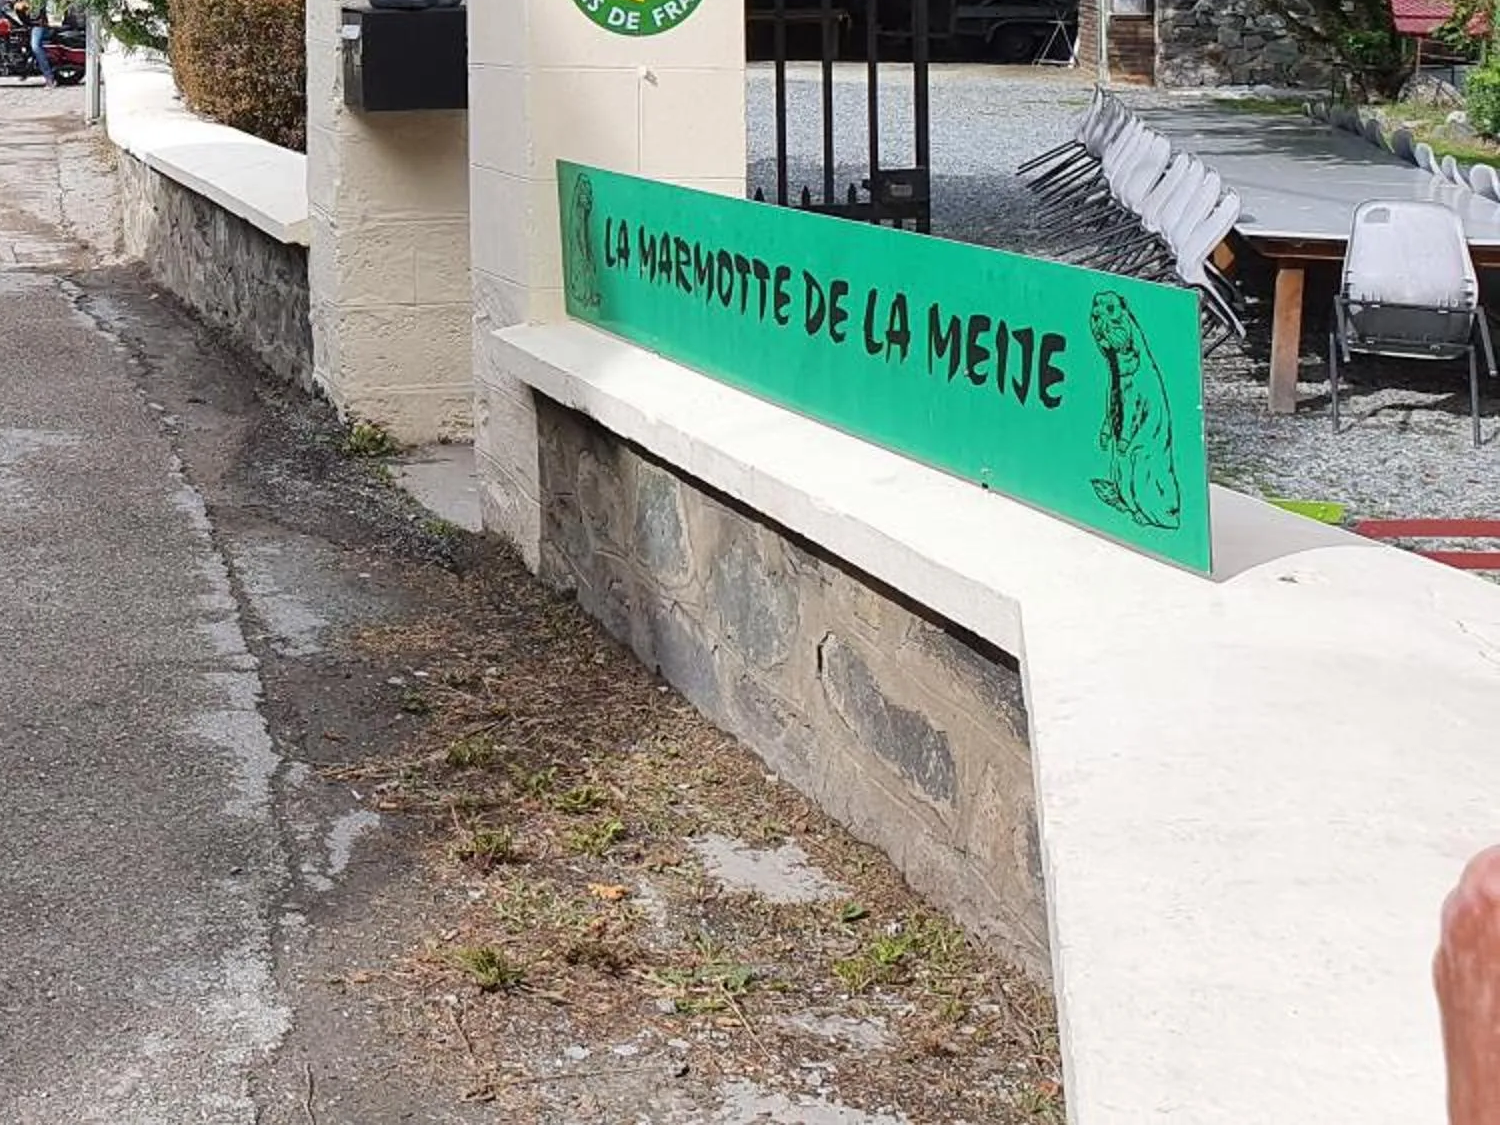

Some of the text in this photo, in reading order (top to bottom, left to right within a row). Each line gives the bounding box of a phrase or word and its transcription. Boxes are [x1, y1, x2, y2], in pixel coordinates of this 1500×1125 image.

[607, 6, 641, 30] DE
[604, 216, 1067, 409] LA MARMOTTE DE LA MEIJE
